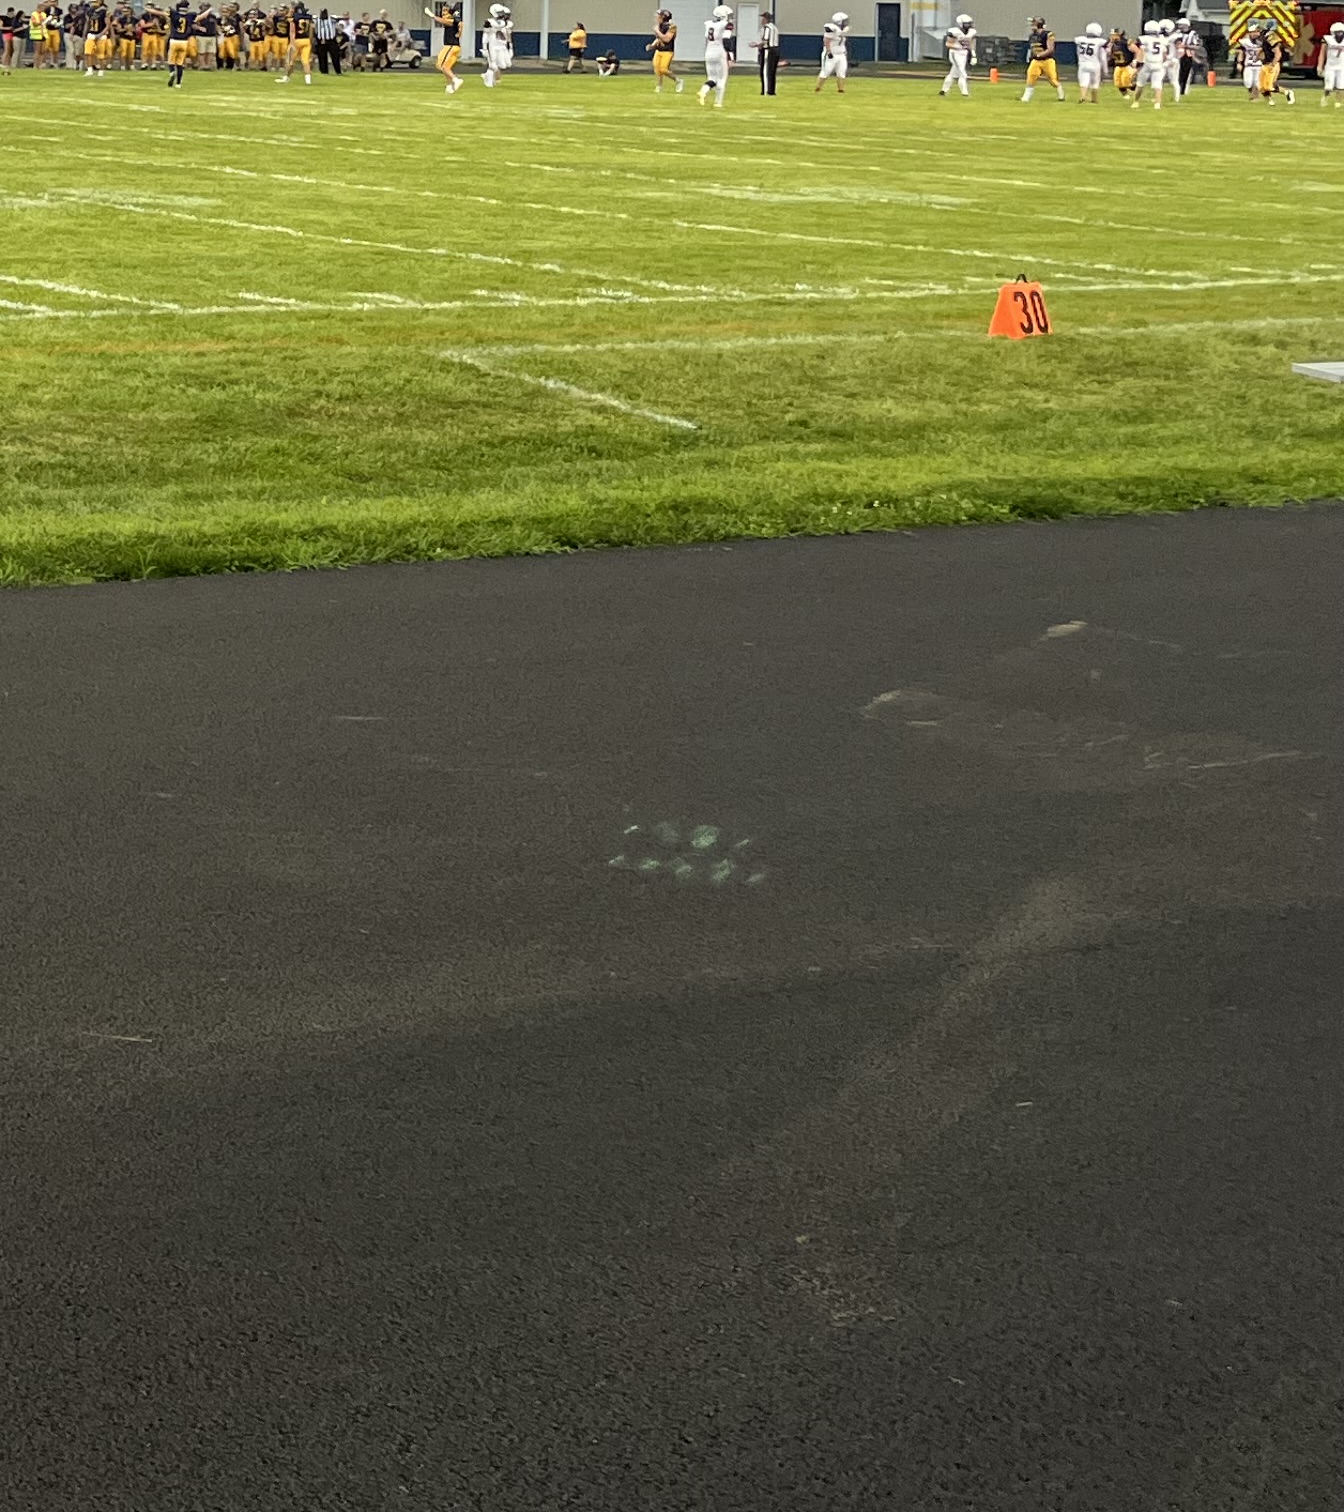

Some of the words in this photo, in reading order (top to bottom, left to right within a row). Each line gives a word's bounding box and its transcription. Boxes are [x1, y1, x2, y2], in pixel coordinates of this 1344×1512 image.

[177, 17, 187, 34] 3
[1153, 42, 1160, 54] 5
[1014, 290, 1048, 334] 30
